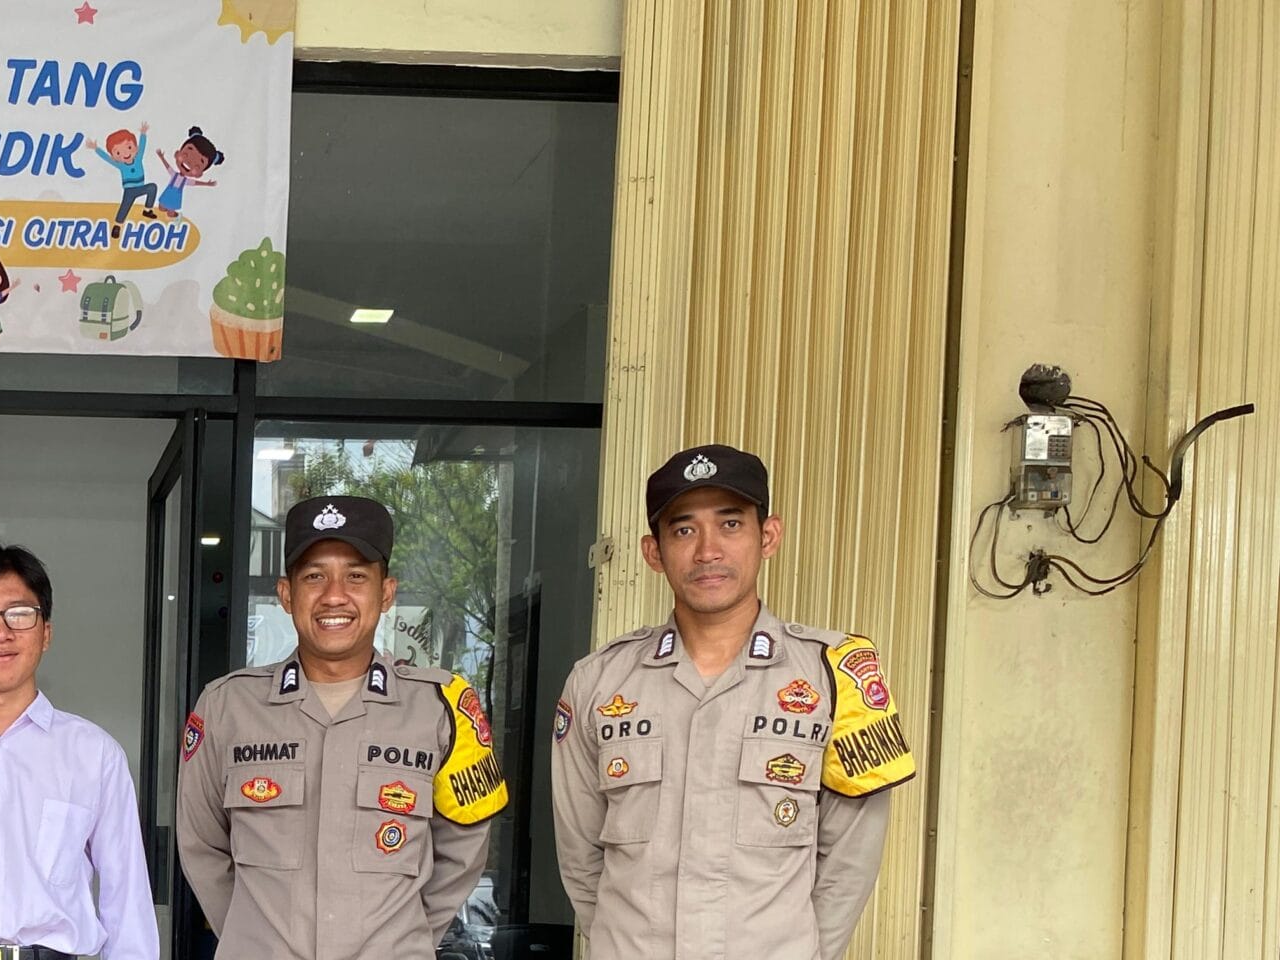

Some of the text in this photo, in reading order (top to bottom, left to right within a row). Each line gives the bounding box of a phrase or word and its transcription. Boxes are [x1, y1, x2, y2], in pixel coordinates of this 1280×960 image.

[23, 218, 109, 248] CITRA
[121, 222, 188, 251] HOH
[601, 719, 652, 741] ORO
[752, 715, 830, 743] POLRI
[233, 742, 299, 763] ROHMAT
[367, 744, 434, 771] POLRI
